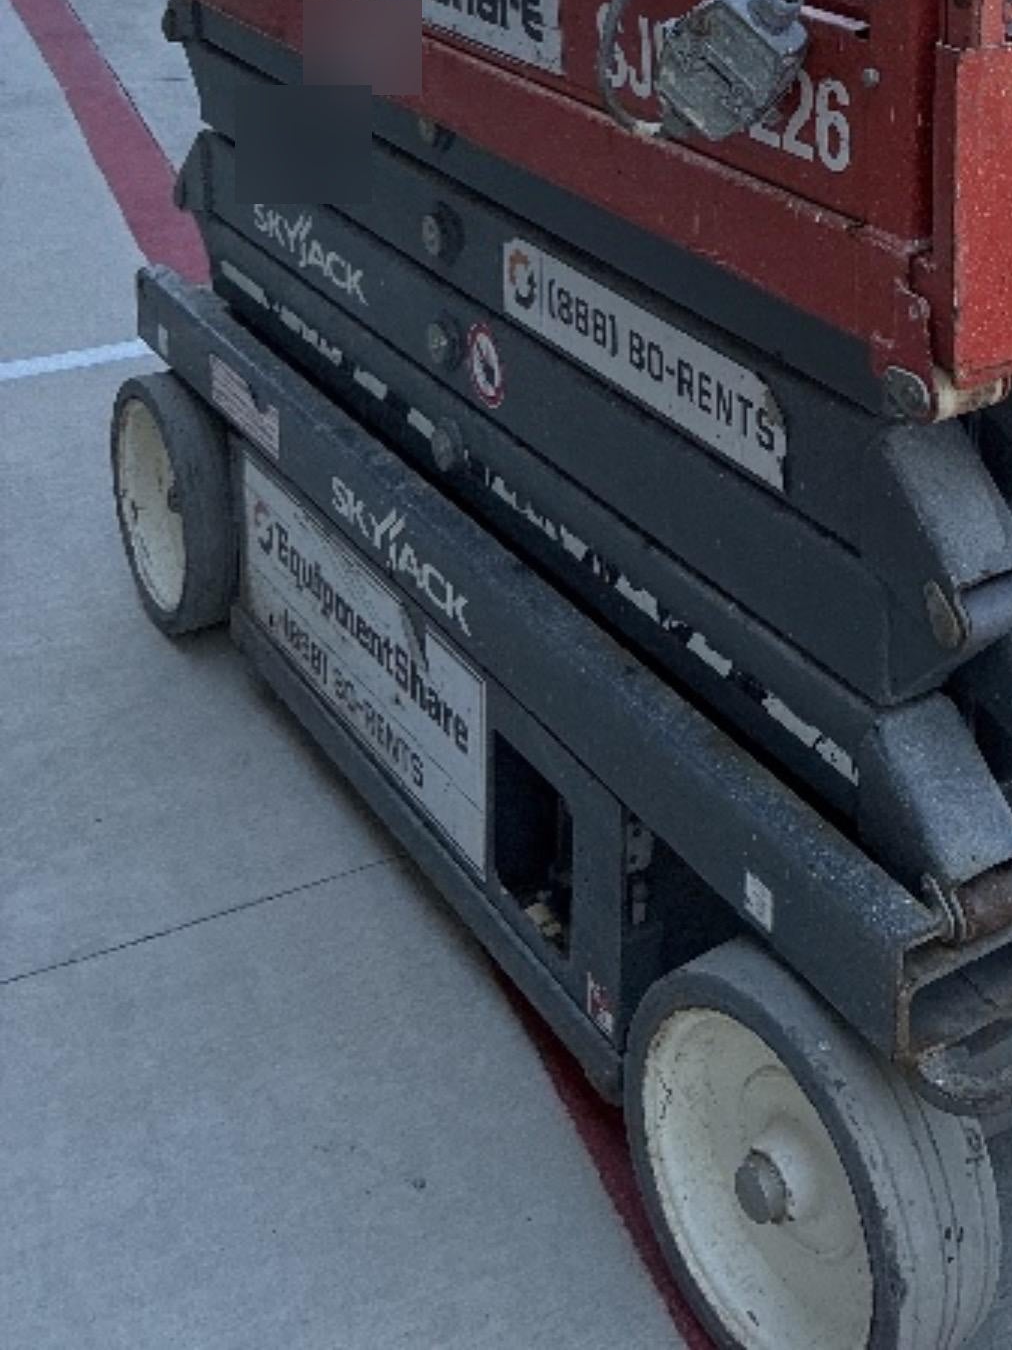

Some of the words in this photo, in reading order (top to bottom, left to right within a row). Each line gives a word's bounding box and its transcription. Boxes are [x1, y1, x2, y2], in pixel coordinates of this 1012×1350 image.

[253, 203, 370, 307] SKYJACK
[547, 277, 619, 359] (888)
[628, 328, 778, 452] 80-RENTS
[275, 520, 470, 756] EquipmentShare
[331, 475, 471, 637] SKYJACK
